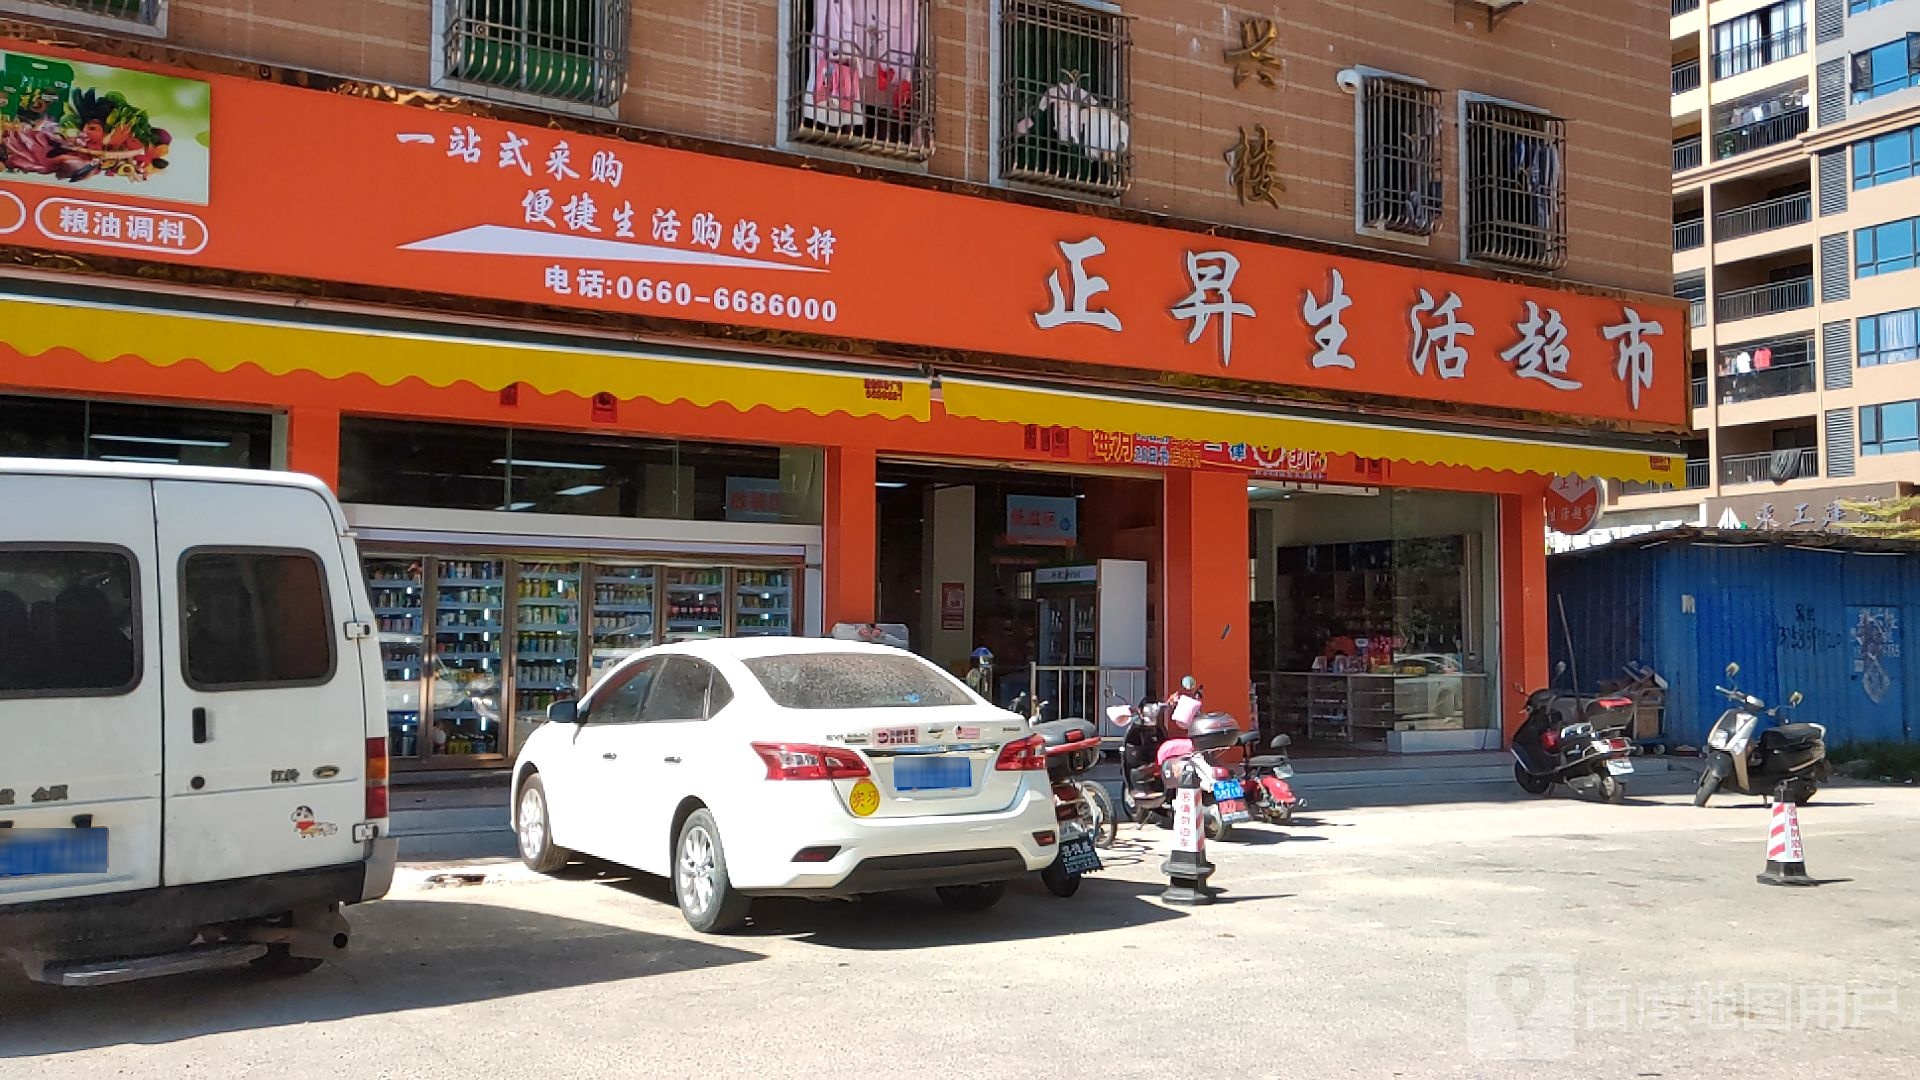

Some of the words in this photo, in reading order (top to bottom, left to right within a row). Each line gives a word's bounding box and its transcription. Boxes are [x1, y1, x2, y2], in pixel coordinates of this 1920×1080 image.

[1223, 17, 1287, 210] 兴楼
[396, 126, 624, 188] 一站式采购
[59, 205, 187, 246] 粮油调料
[521, 188, 838, 265] 便捷生活购好选择
[545, 264, 838, 323] 电话:0660-6686000
[1034, 235, 1664, 410] 正昇生活超市
[853, 788, 880, 809] 实习
